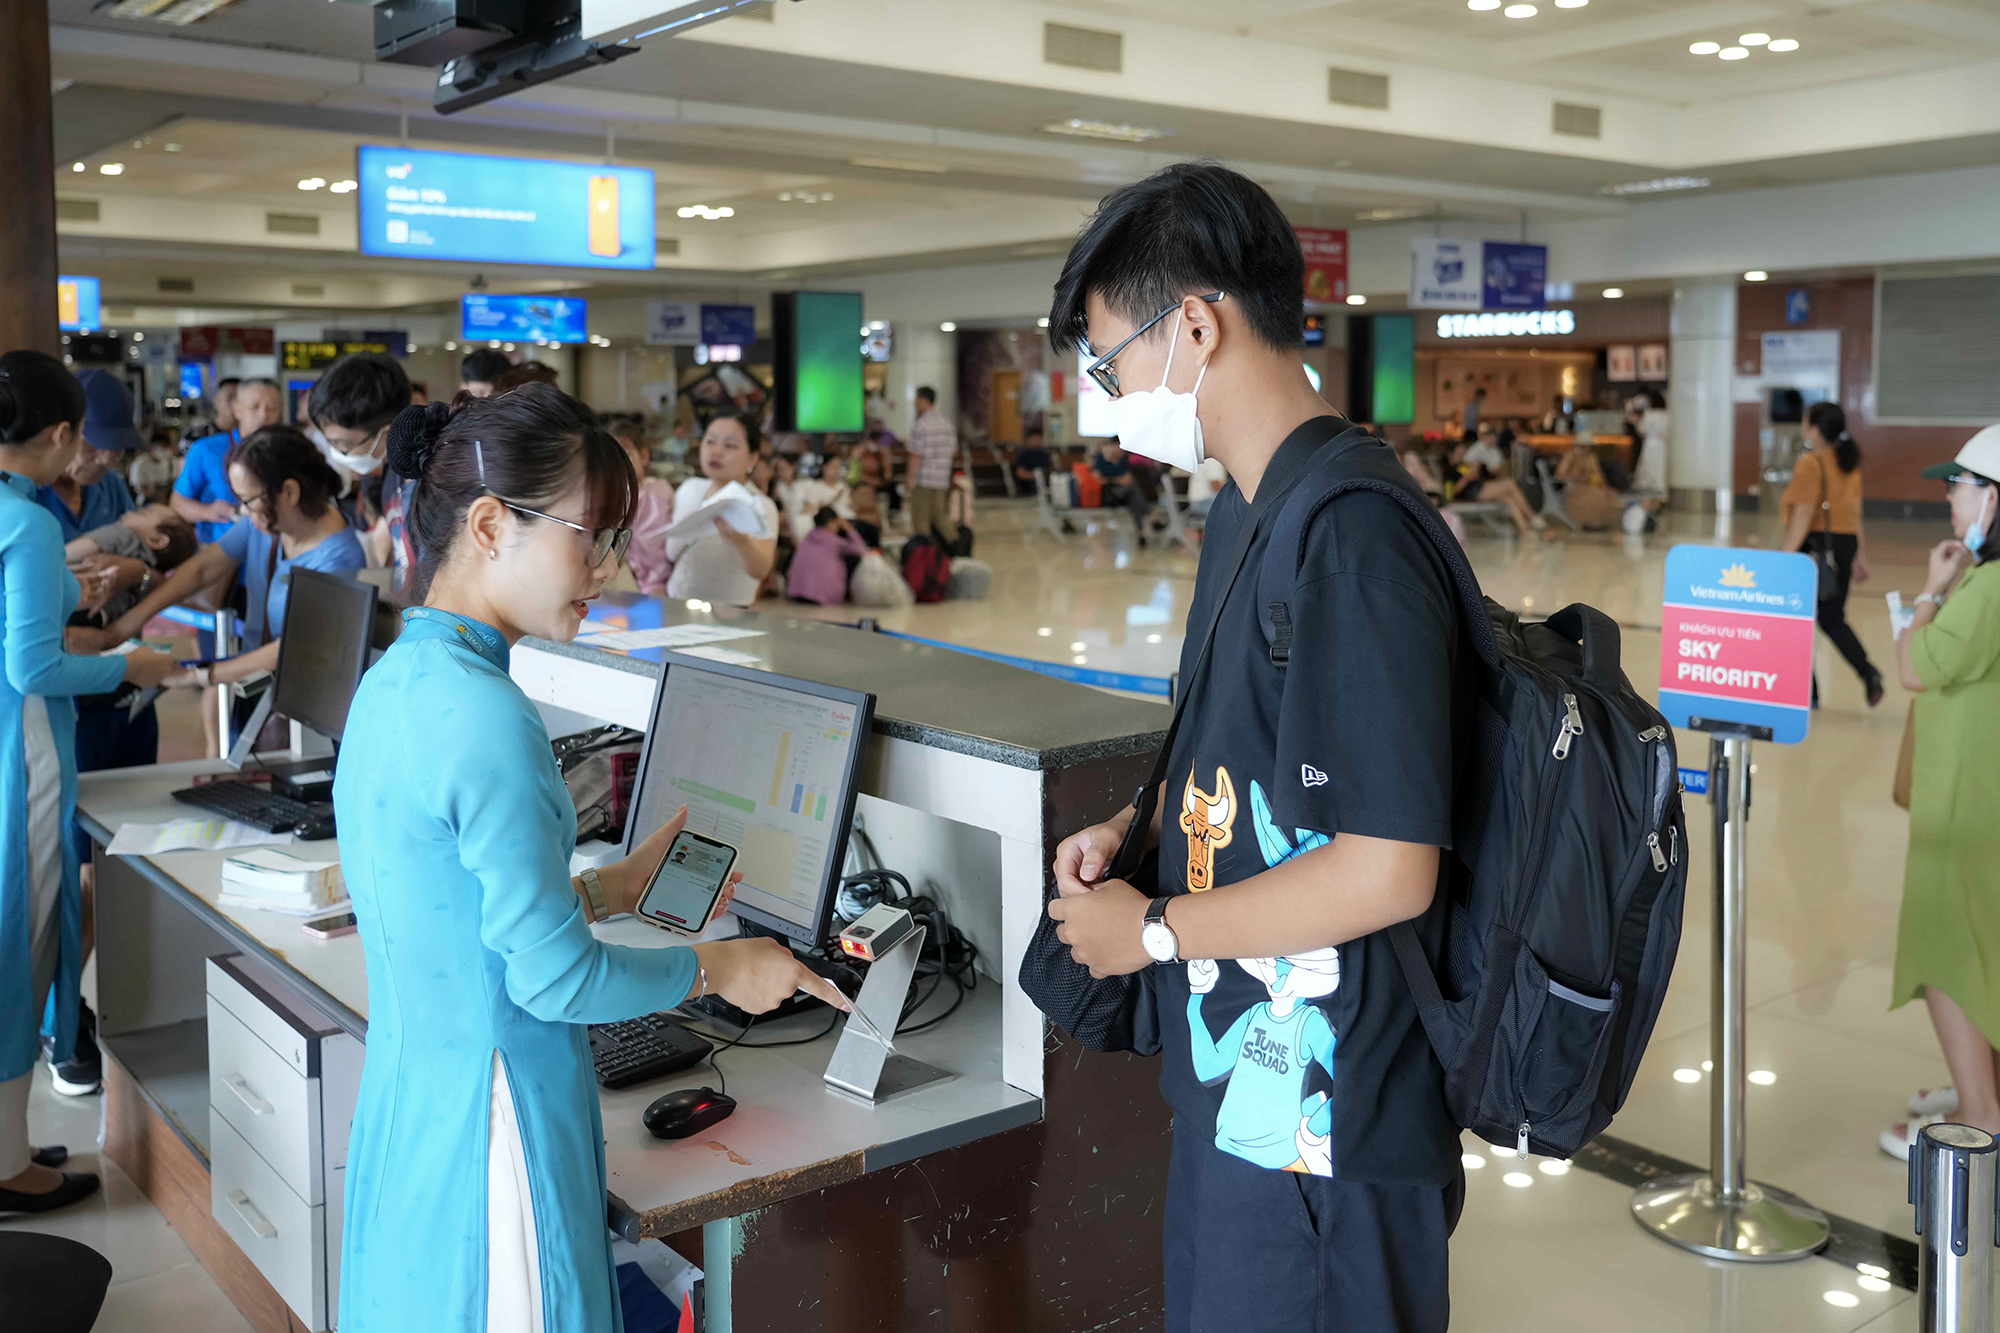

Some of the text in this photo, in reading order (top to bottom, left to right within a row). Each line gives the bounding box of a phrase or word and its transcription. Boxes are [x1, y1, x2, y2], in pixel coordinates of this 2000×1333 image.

[1437, 310, 1575, 338] STARBUCKS
[1690, 584, 1785, 606] Vietnam Airlines
[466, 633, 483, 652] VIAGS
[1679, 622, 1716, 636] KHÁCH
[1736, 627, 1761, 641] TIÊN
[1678, 638, 1721, 660] SKY
[1677, 662, 1778, 691] PRIORITY
[1253, 1026, 1289, 1060] TUNE
[1242, 1041, 1289, 1075] SQUAD
